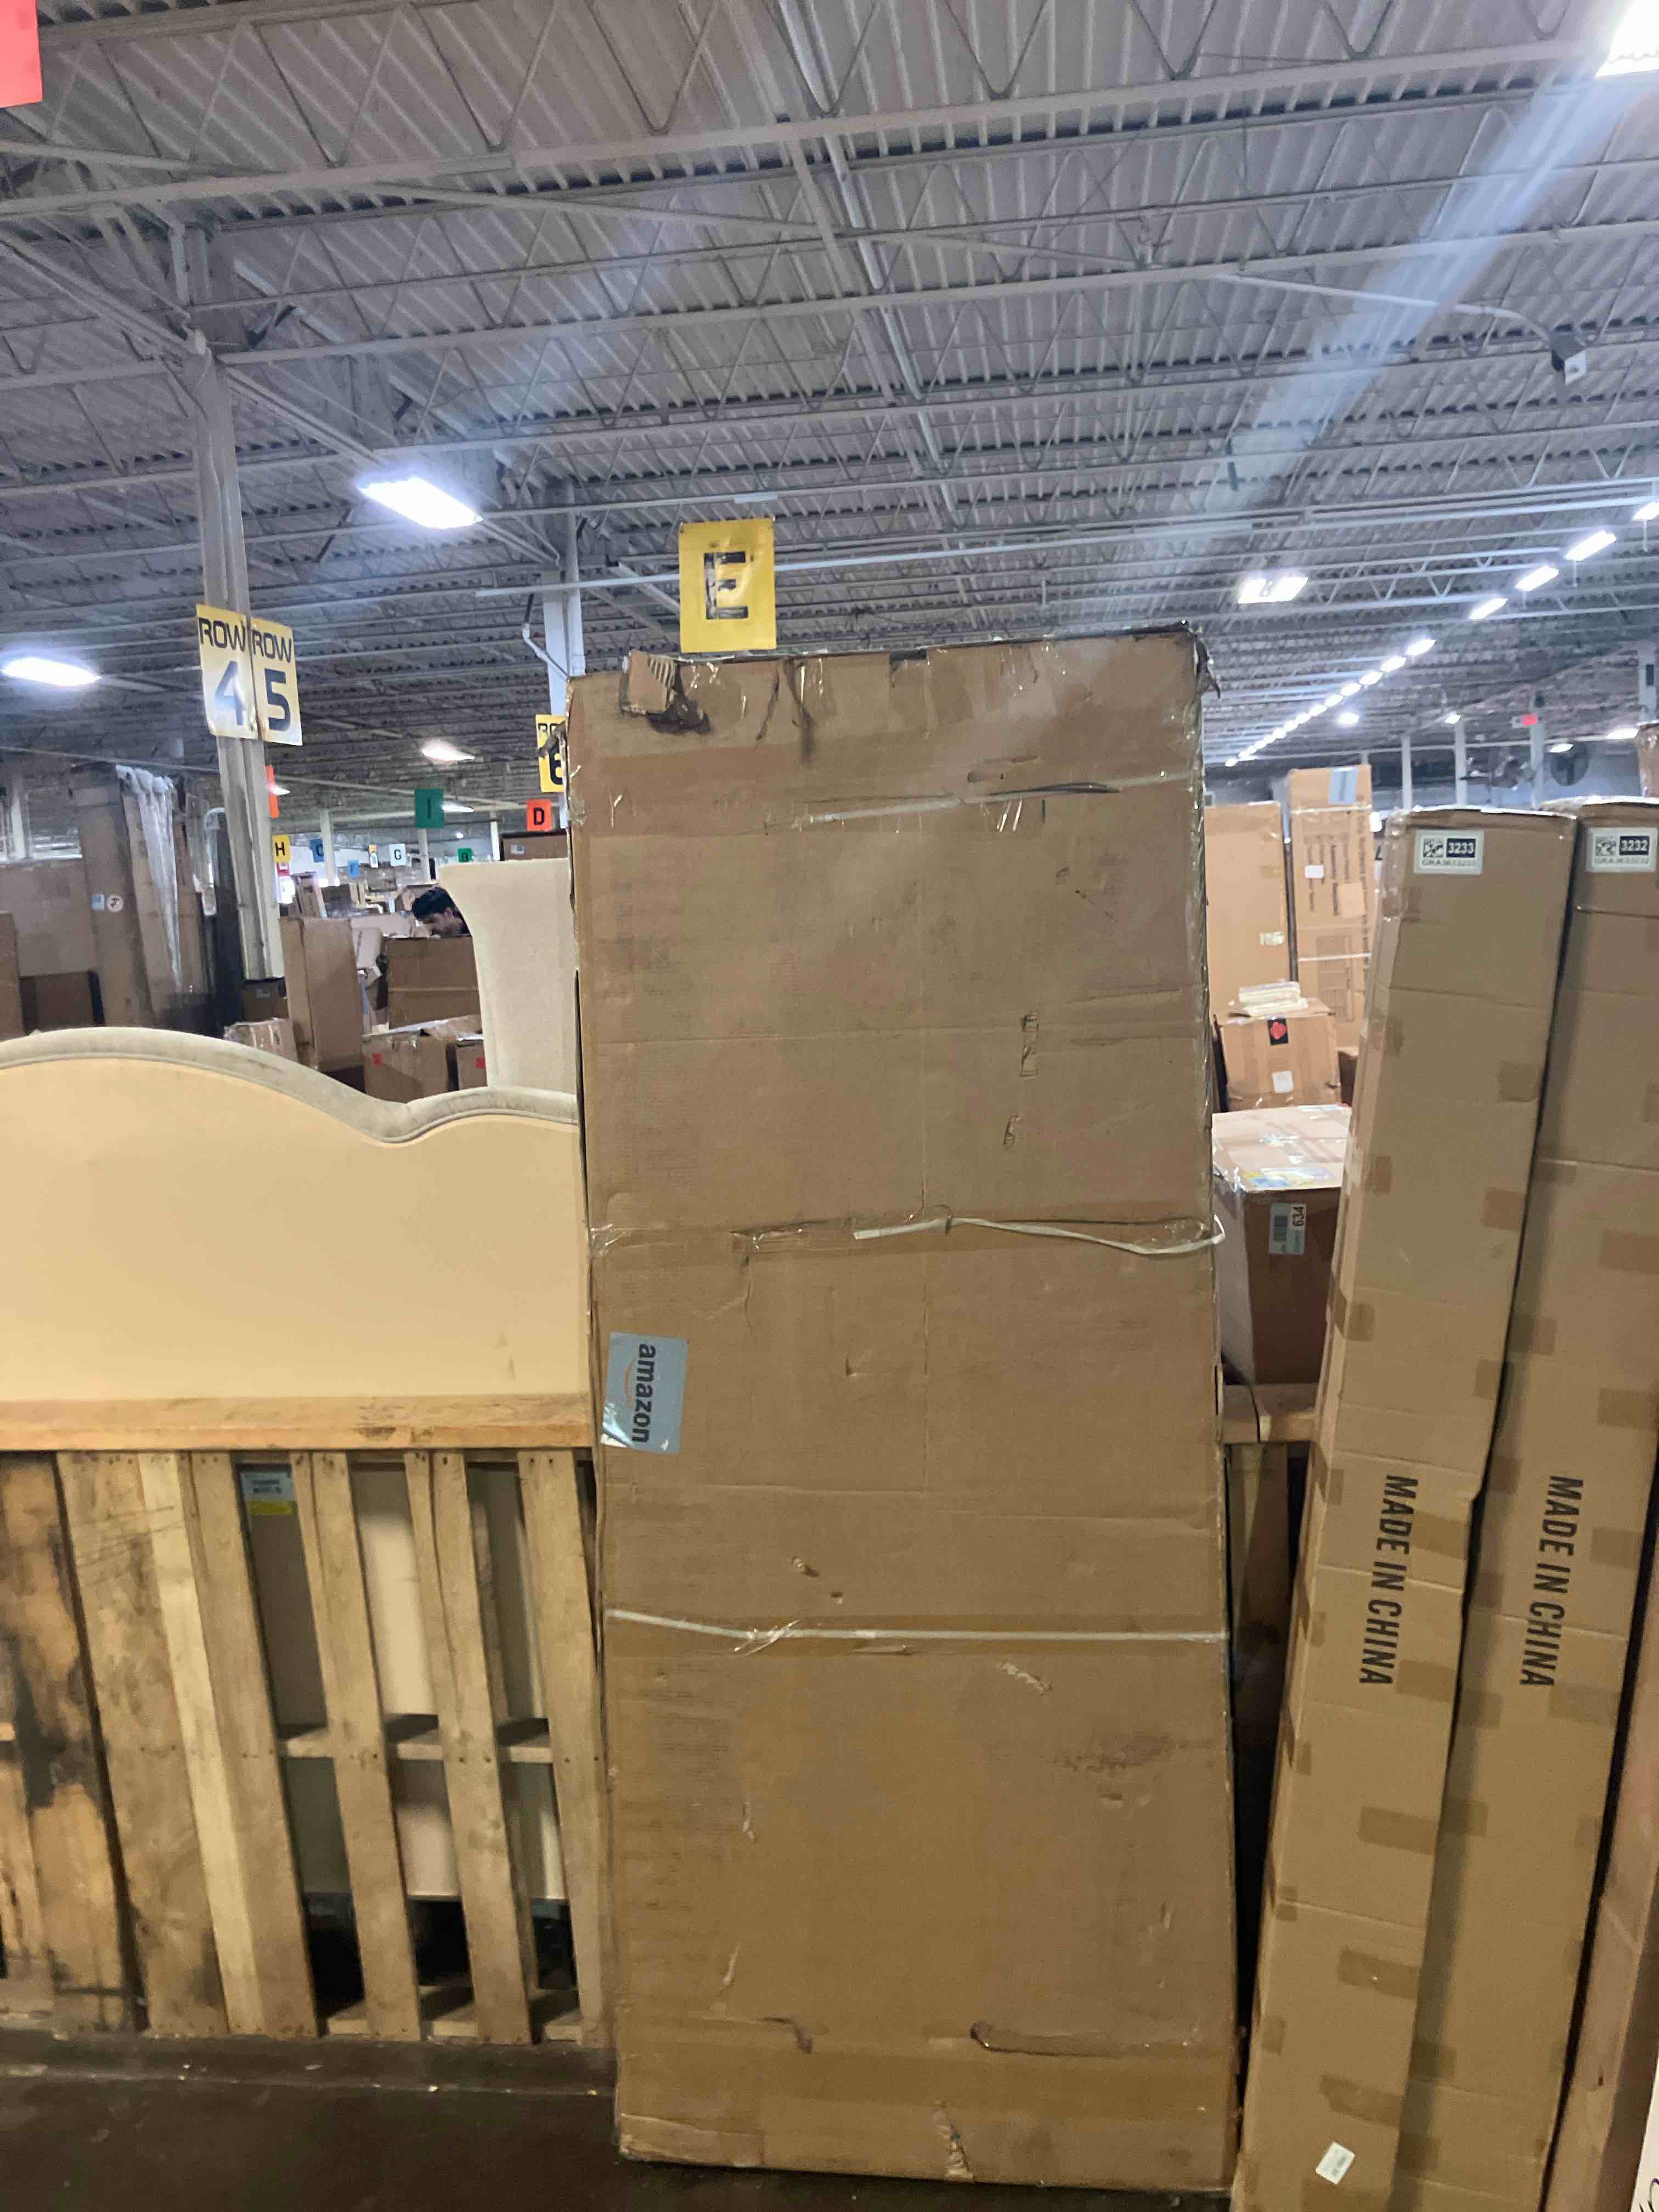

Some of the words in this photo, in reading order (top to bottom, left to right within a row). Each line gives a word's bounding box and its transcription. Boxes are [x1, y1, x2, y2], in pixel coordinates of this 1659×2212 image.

[704, 551, 748, 620] E
[199, 618, 246, 652] ROW
[252, 629, 292, 663] ROW
[215, 661, 245, 726] 4
[264, 668, 291, 732] 5
[533, 807, 545, 826] D
[274, 841, 286, 856] H
[394, 849, 402, 860] G
[1448, 842, 1474, 854] 3233
[1622, 839, 1647, 851] 3232
[1293, 1206, 1304, 1226] 634
[631, 1344, 656, 1443] amazon
[1376, 1475, 1419, 1555] MADE
[1539, 1475, 1584, 1556] MADE
[1371, 1561, 1408, 1592] IN
[1533, 1563, 1571, 1594] IN
[1359, 1599, 1402, 1684] CHINA
[1519, 1601, 1566, 1686] CHINA
